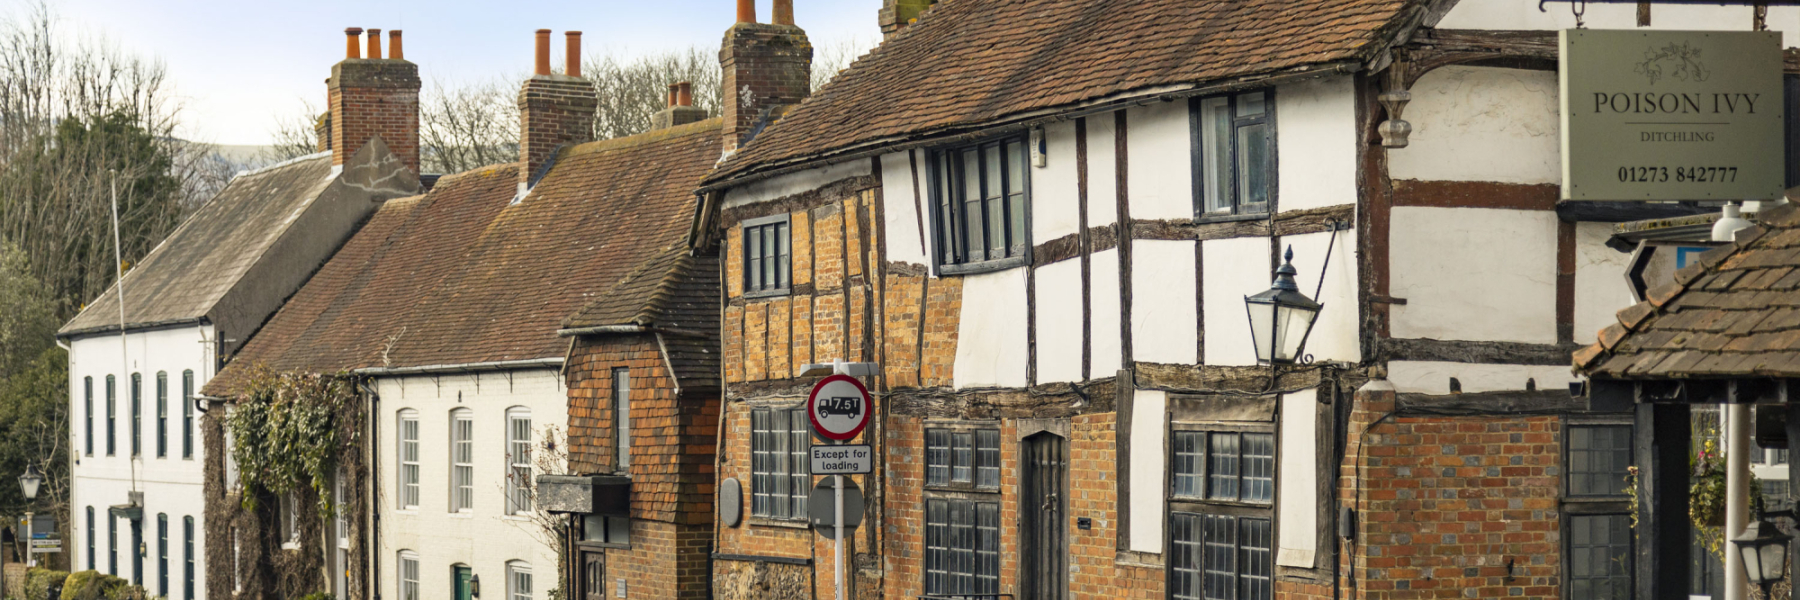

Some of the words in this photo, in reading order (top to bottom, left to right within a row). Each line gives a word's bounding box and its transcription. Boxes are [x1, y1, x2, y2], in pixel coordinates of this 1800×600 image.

[1593, 92, 1701, 114] POISON
[1712, 92, 1760, 114] IVY
[1640, 131, 1715, 142] DITCHLING
[1618, 166, 1669, 183] 01273
[1676, 166, 1738, 183] 842777
[833, 398, 859, 410] 7.5T
[814, 449, 849, 460] Except
[853, 449, 867, 458] for
[822, 461, 859, 471] loading
